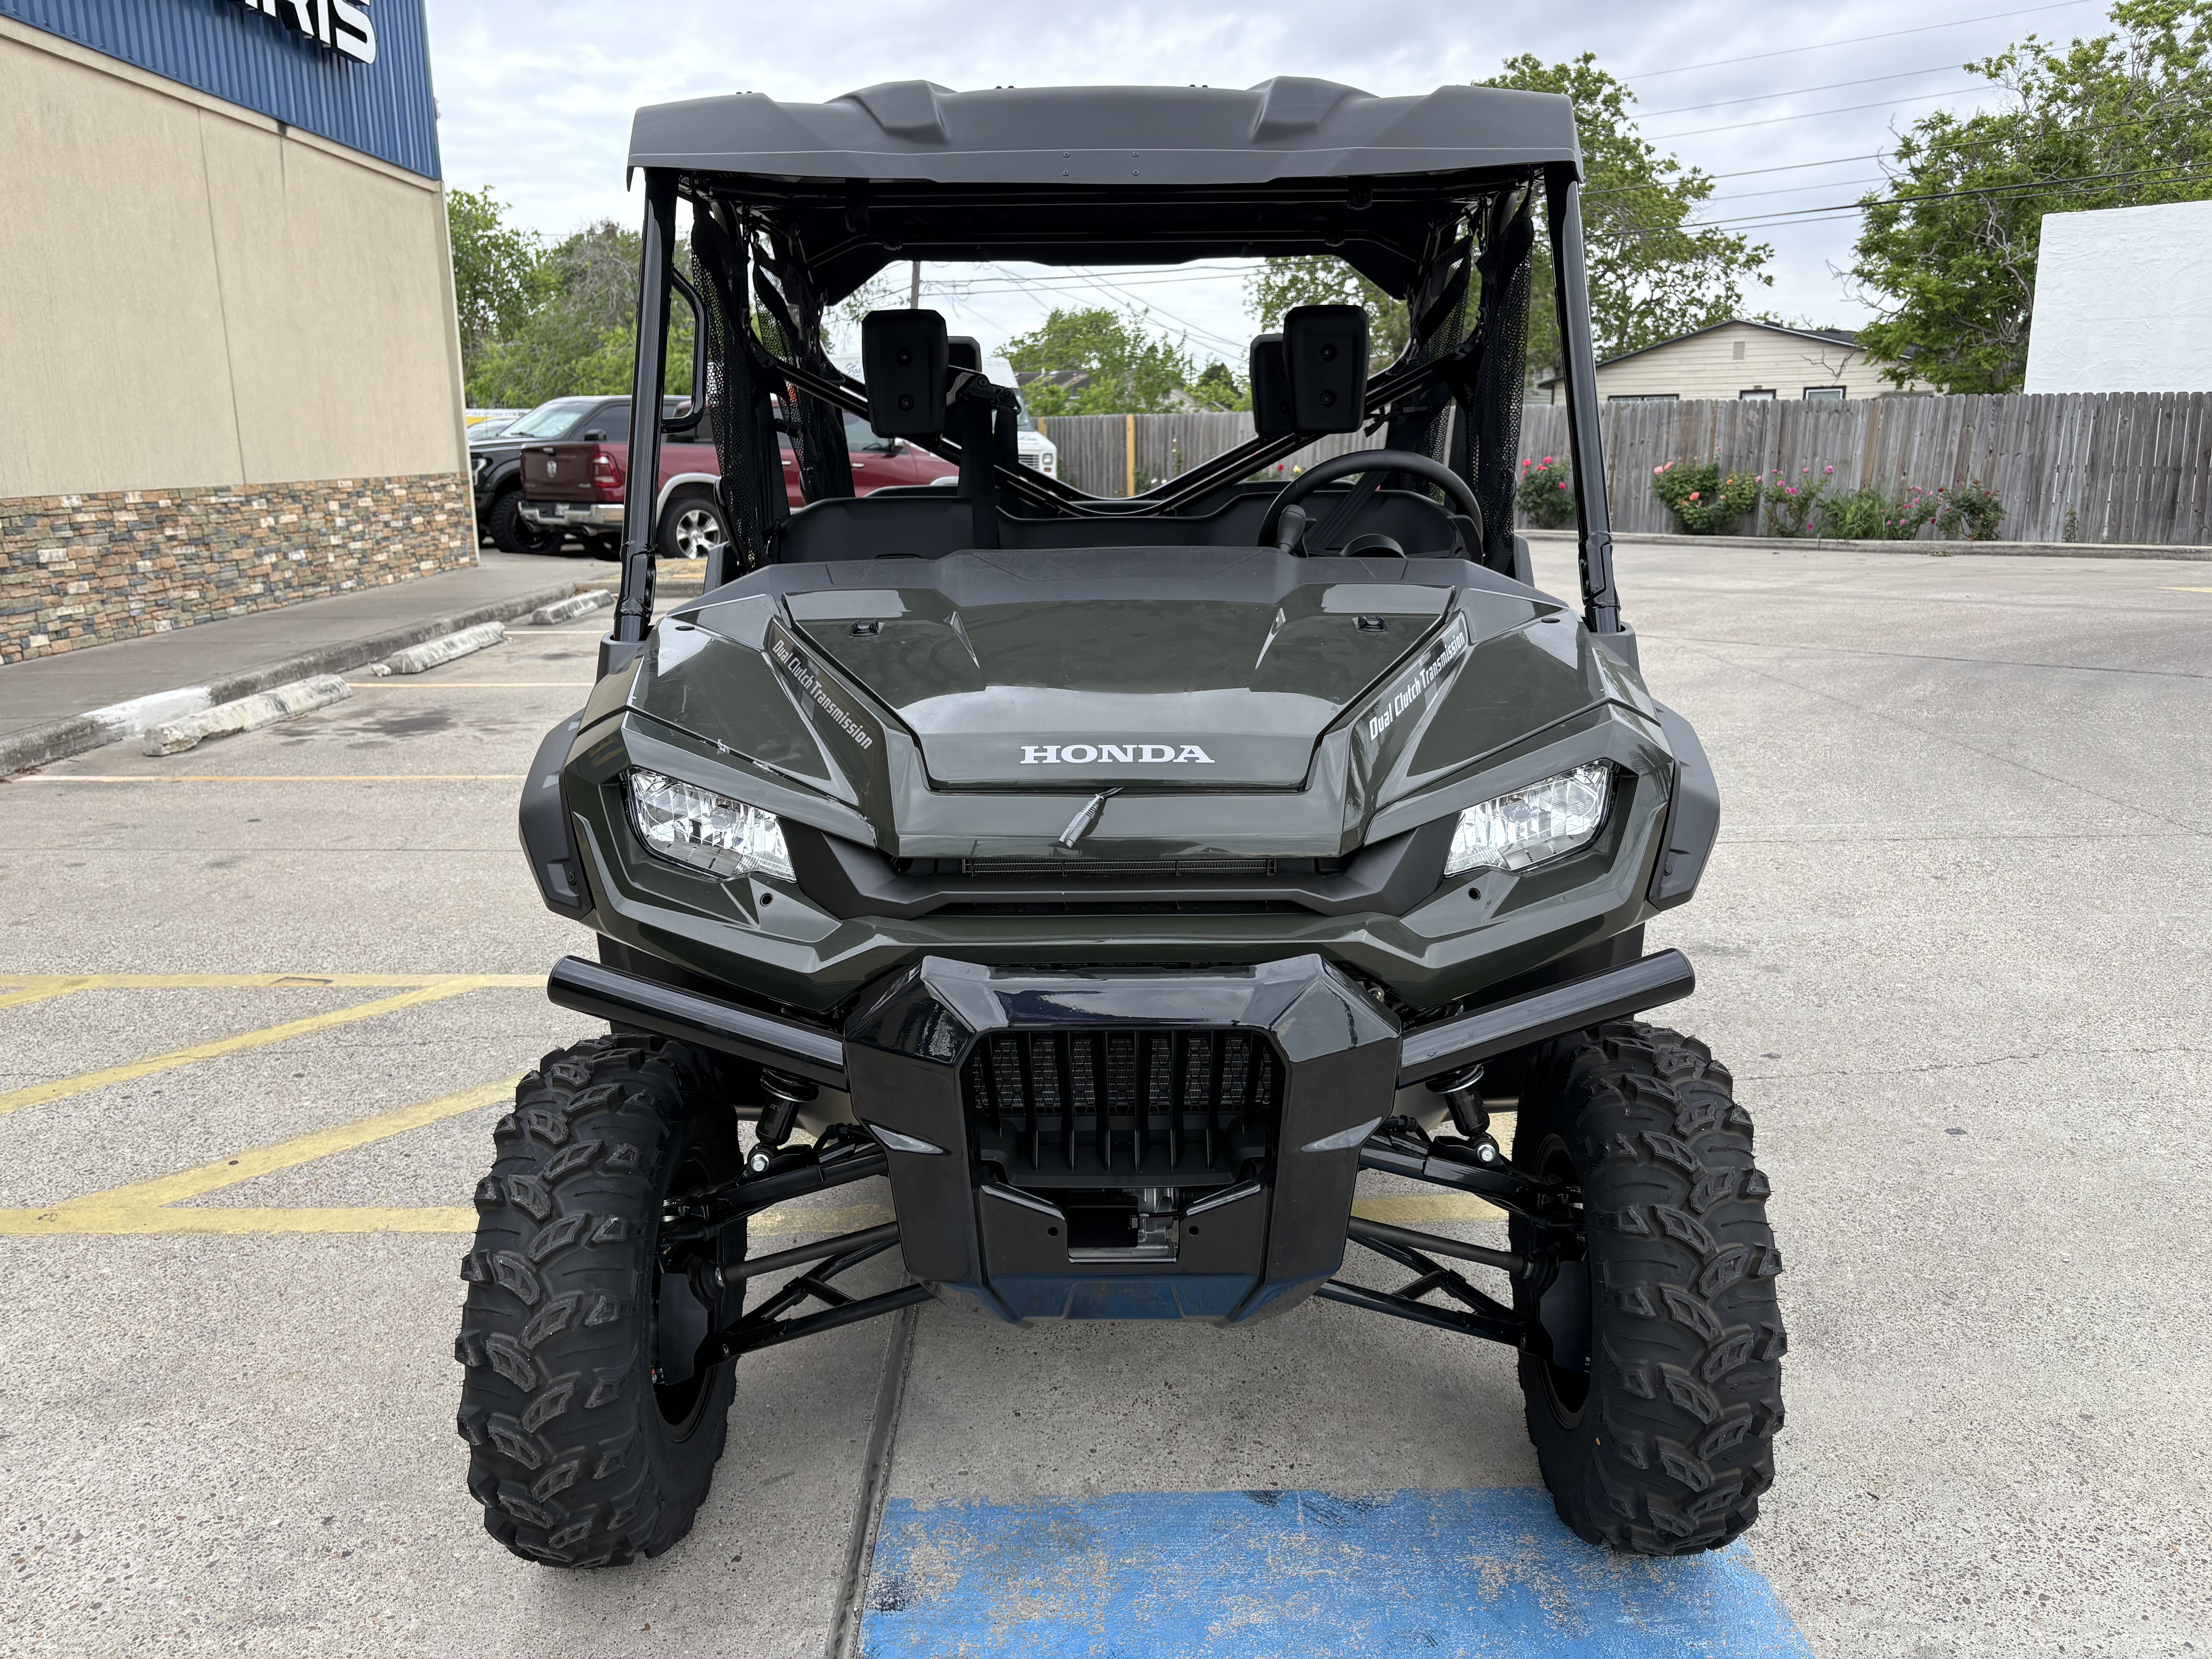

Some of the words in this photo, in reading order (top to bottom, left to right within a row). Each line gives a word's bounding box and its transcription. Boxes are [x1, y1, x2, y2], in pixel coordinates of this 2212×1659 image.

[772, 639, 793, 664] Dual
[787, 657, 814, 689] Clutch
[810, 681, 873, 750] Transmission
[1369, 703, 1393, 741] Dual
[1394, 677, 1422, 717] Clutch
[1419, 631, 1465, 689] Transmission
[1020, 744, 1215, 764] HONDA
